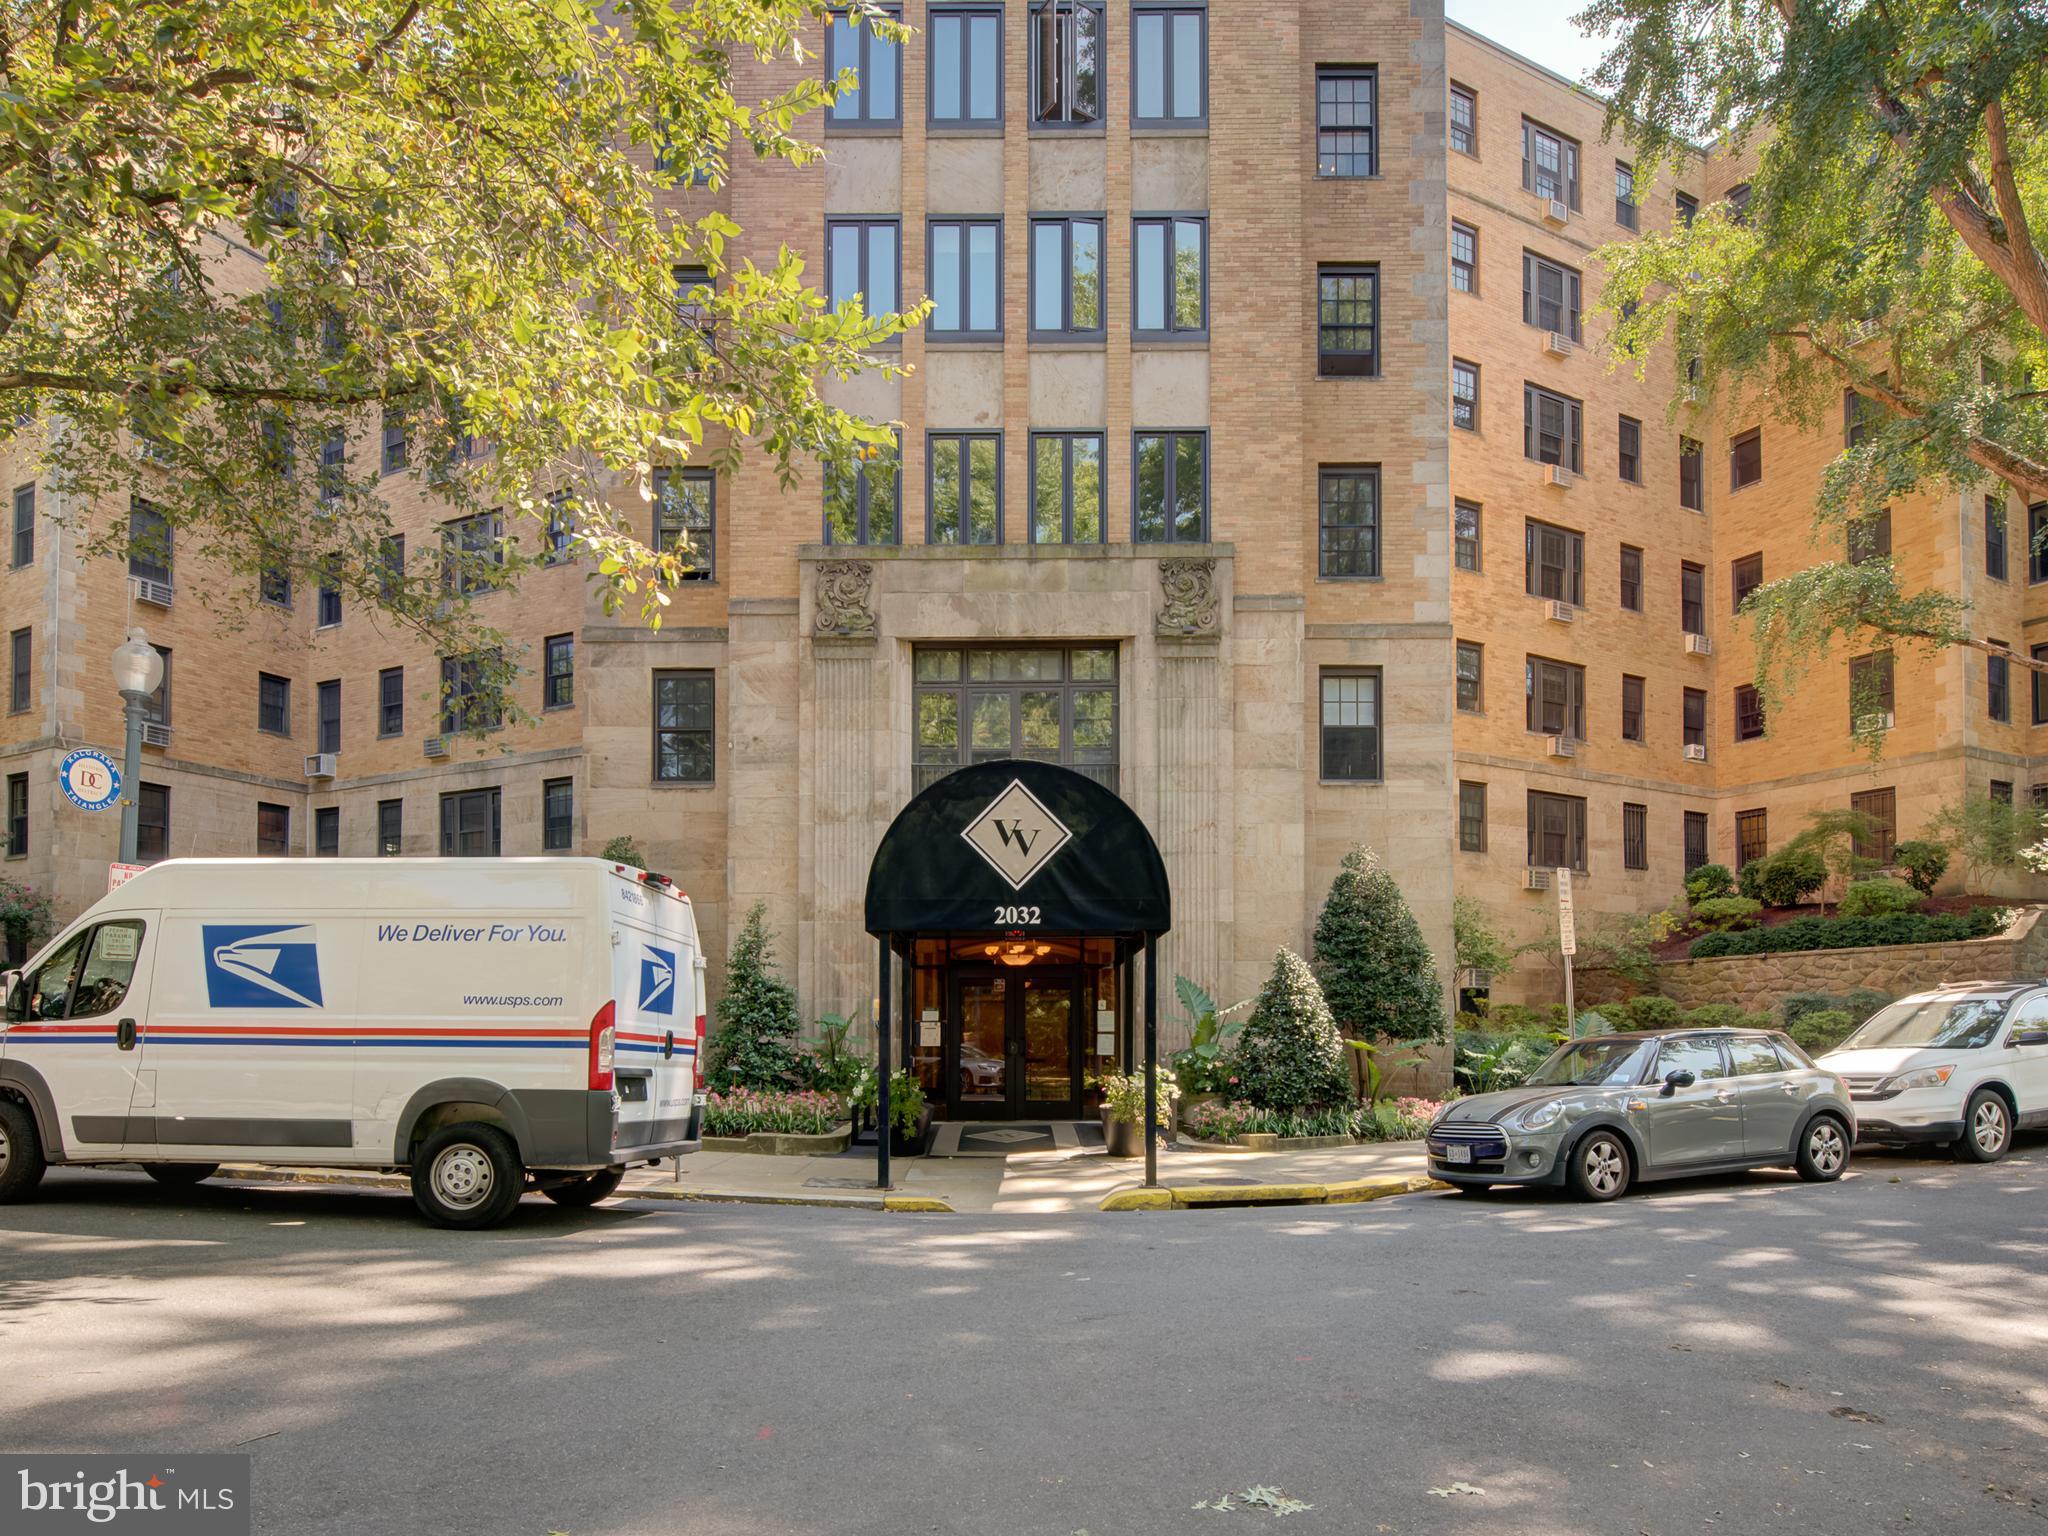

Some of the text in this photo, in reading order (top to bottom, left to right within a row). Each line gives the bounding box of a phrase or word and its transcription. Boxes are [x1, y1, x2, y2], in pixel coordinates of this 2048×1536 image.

[66, 751, 117, 773] KALORAMA
[81, 771, 103, 789] DC
[68, 790, 113, 810] TRIANGLE
[994, 906, 1041, 924] 2032
[378, 925, 567, 942] We Deliver For You.
[463, 995, 563, 1008] www.usps.com
